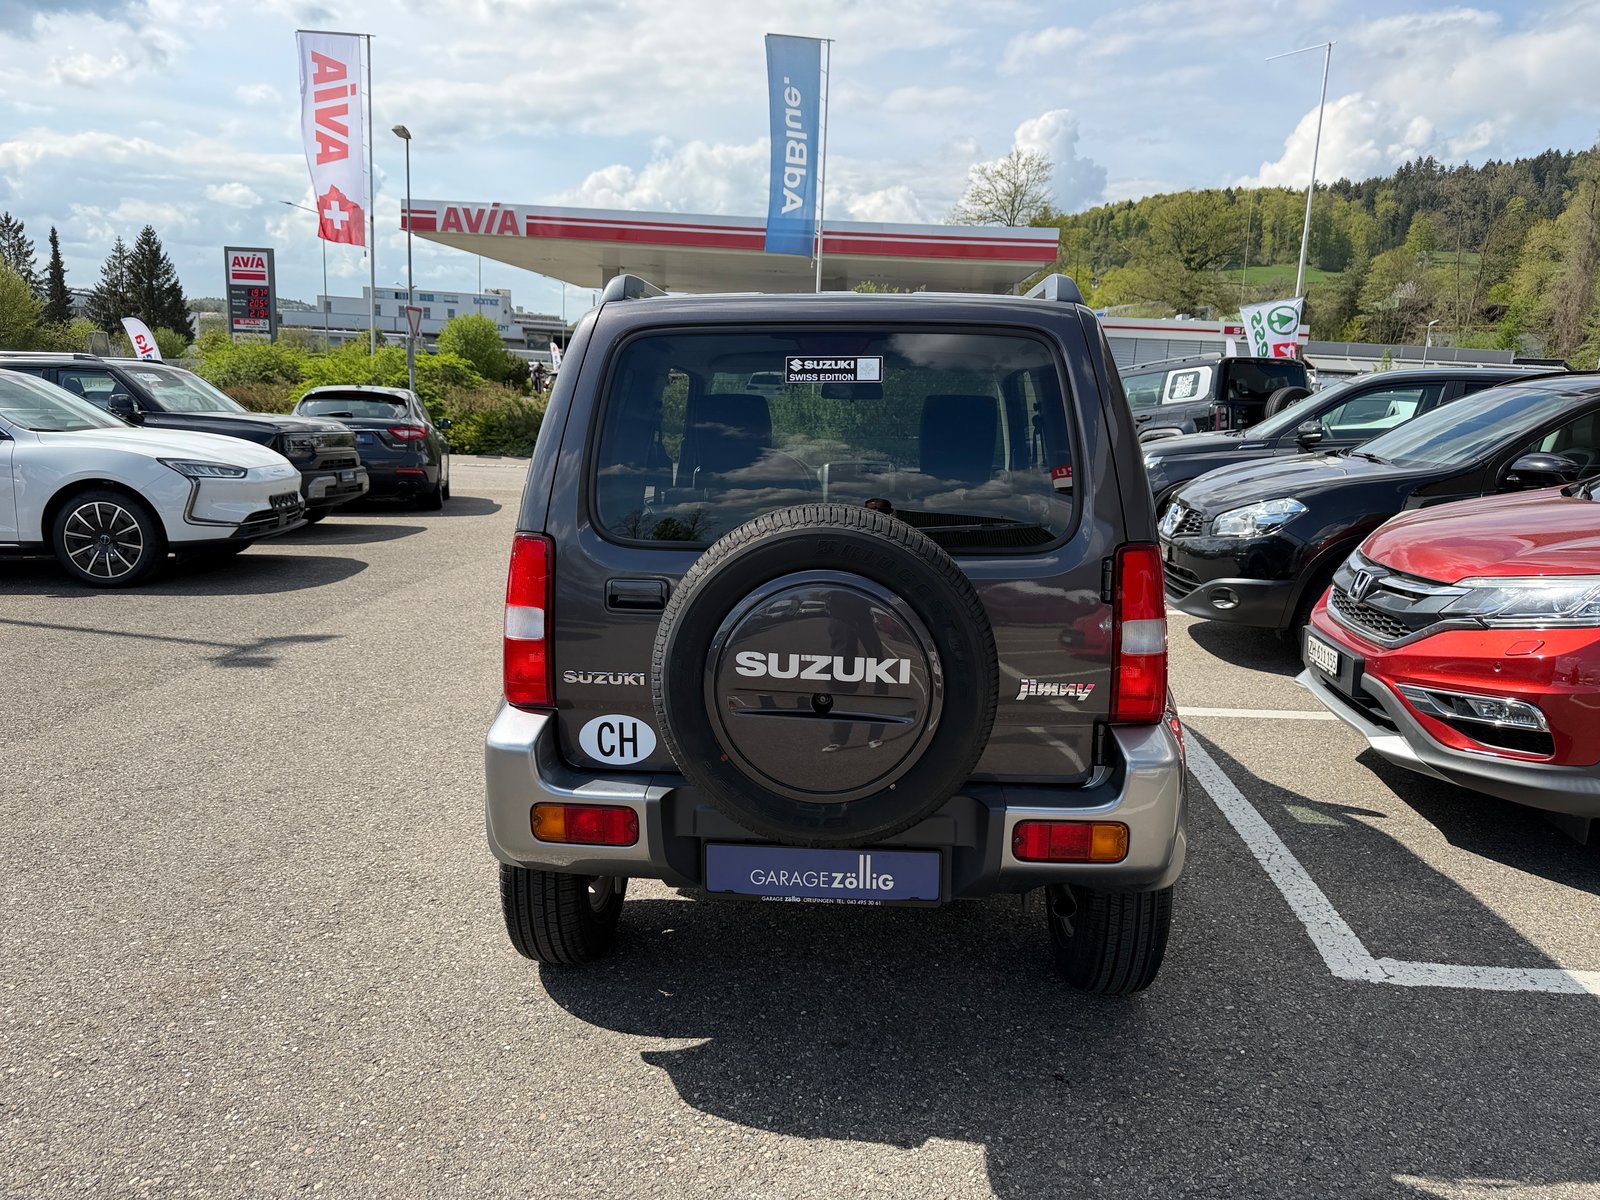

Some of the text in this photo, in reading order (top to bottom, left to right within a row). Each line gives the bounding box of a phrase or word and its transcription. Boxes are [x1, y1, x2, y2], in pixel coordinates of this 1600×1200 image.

[804, 360, 855, 369] SUZUKI
[789, 373, 854, 381] SWISS EDITION
[735, 651, 911, 685] SUZUKI
[563, 670, 646, 686] SUZUKI
[597, 721, 639, 758] CH
[750, 869, 829, 888] GARAGE
